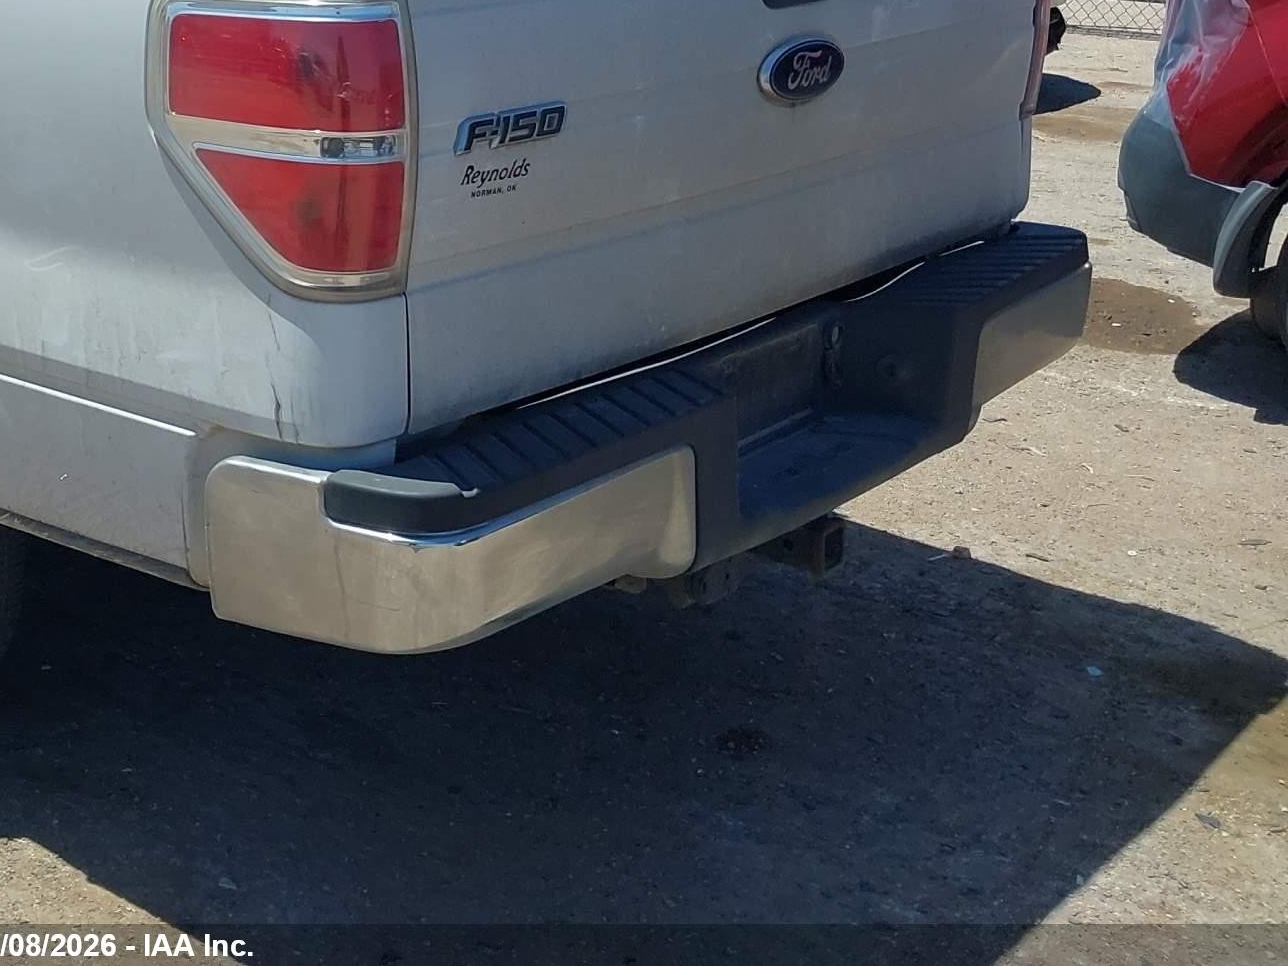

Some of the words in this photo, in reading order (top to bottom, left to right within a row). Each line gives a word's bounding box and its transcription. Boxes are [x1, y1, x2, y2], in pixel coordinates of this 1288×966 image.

[787, 50, 833, 90] Ford
[456, 101, 567, 155] F-150
[460, 157, 531, 187] Reynolds
[506, 185, 517, 193] OK
